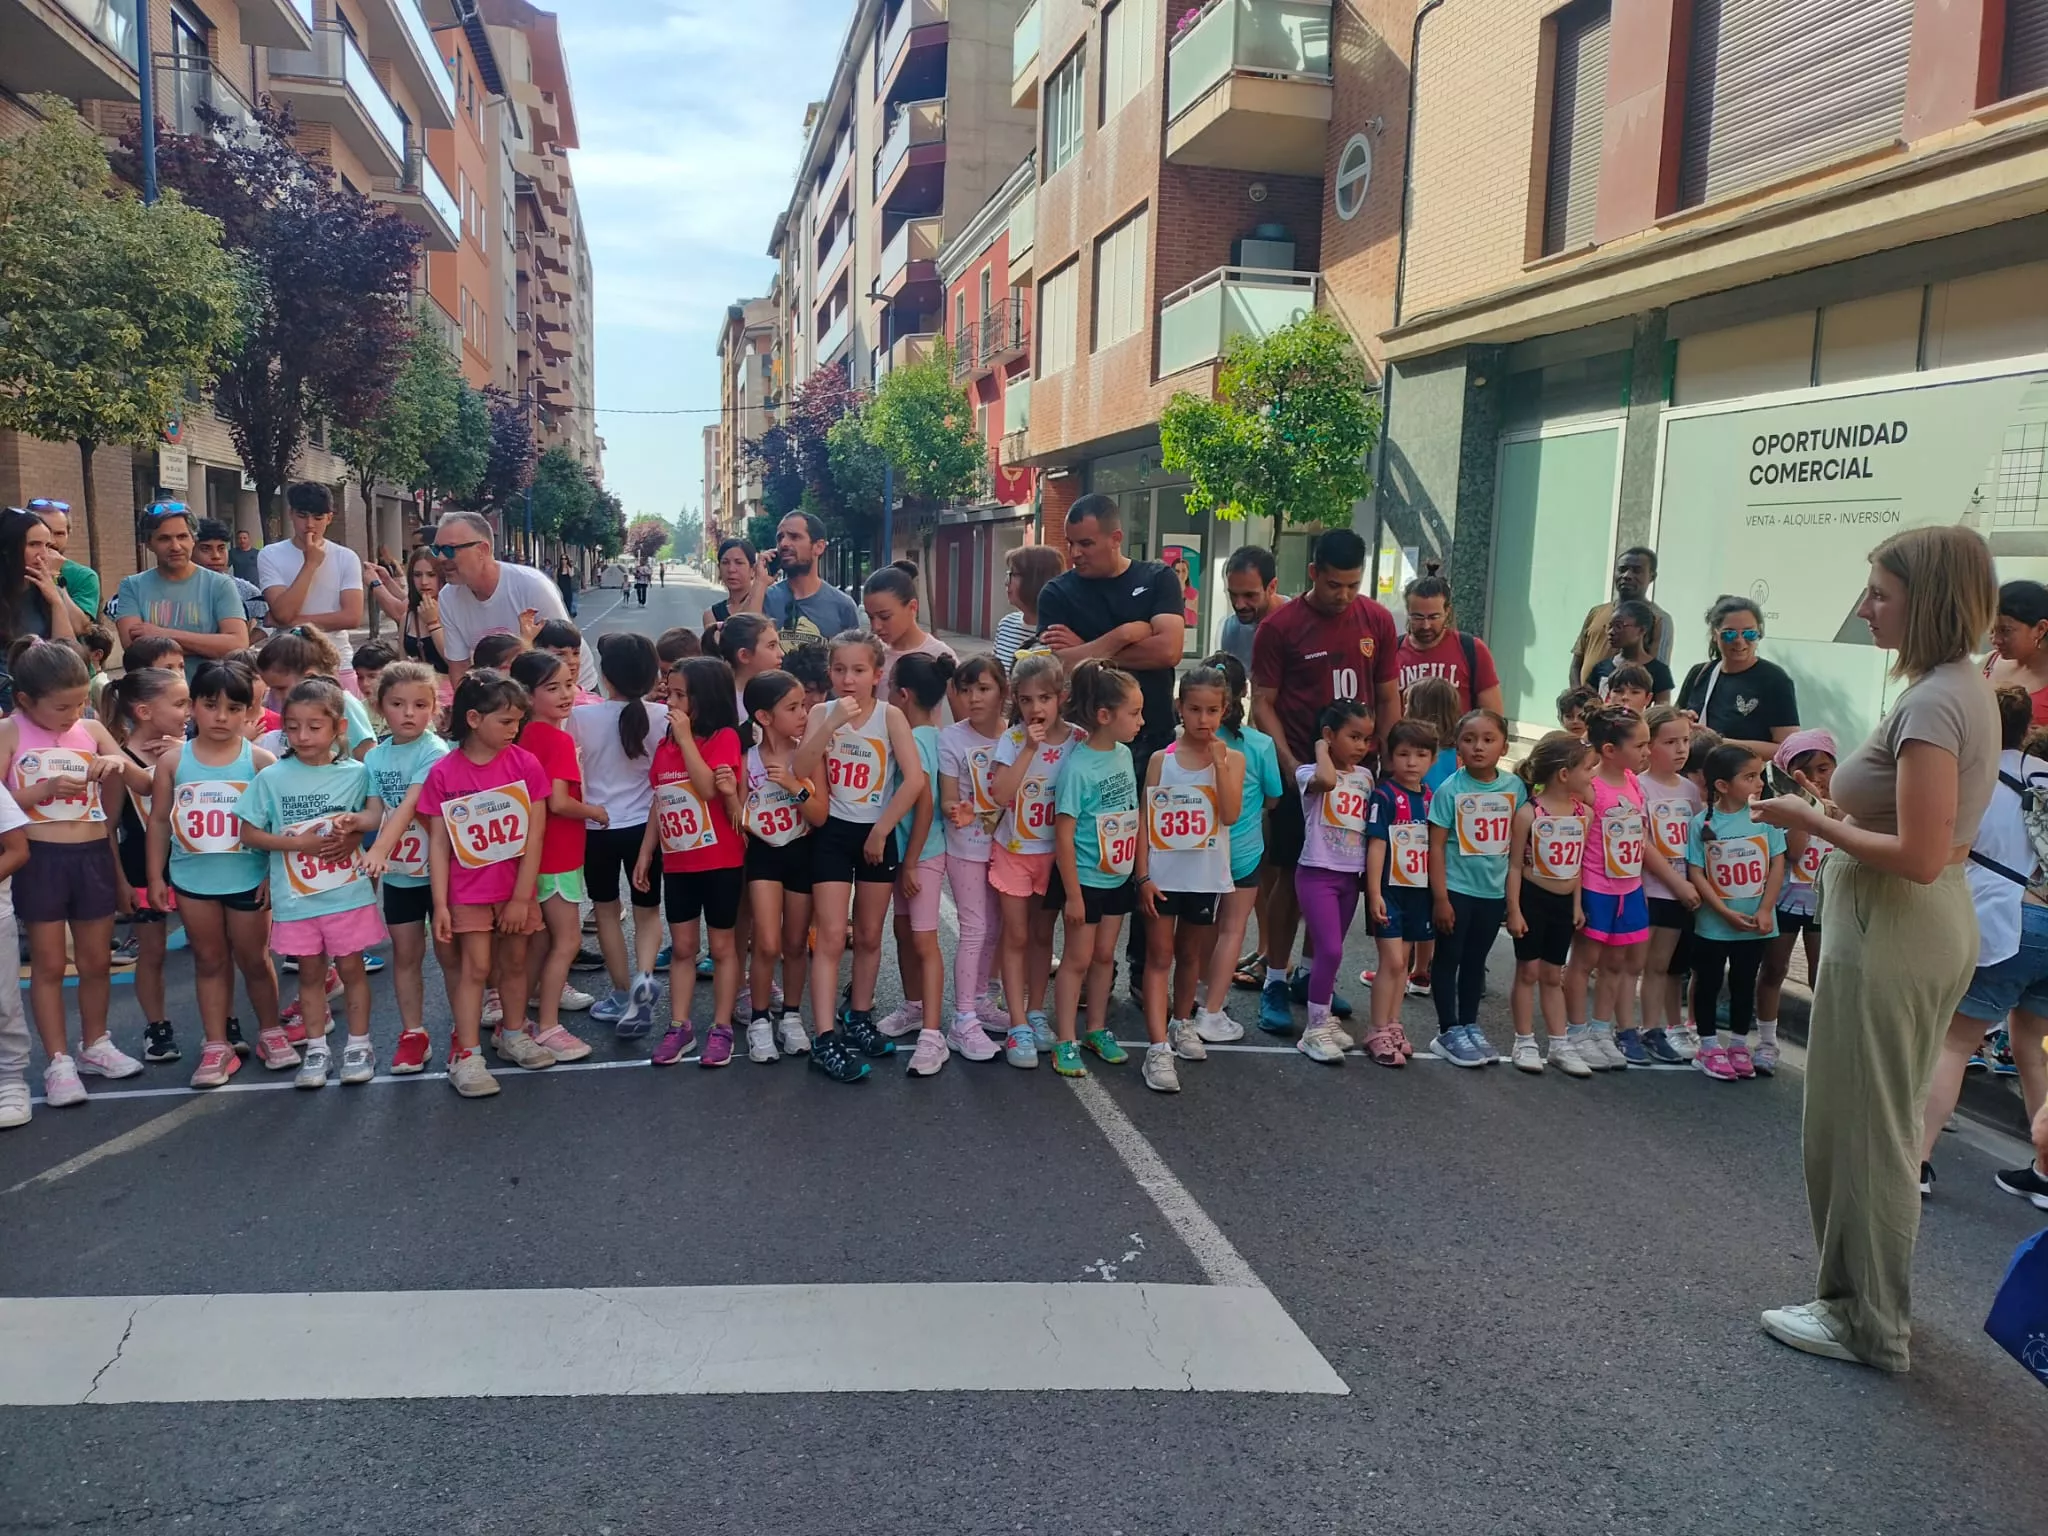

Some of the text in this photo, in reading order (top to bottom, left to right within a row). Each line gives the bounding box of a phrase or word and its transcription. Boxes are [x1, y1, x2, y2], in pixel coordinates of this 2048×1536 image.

[1752, 421, 1908, 456] OPORTUNIDAD
[1749, 456, 1873, 485] COMERCIAL
[1746, 509, 1901, 527] VENTA ALQUILER INVERSIÓN
[1333, 668, 1358, 699] 10
[829, 758, 871, 789] 318
[187, 809, 240, 839] 301
[660, 808, 698, 840] 333
[757, 804, 803, 837] 337
[1029, 801, 1057, 828] 30
[1160, 810, 1207, 837] 335
[467, 814, 524, 852] 342
[1474, 817, 1510, 841] 317
[1666, 821, 1688, 845] 30
[389, 837, 422, 863] 22
[1112, 836, 1135, 865] 30
[1406, 849, 1429, 874] 31
[1549, 841, 1582, 866] 327
[1618, 840, 1643, 865] 32
[1716, 860, 1763, 887] 306
